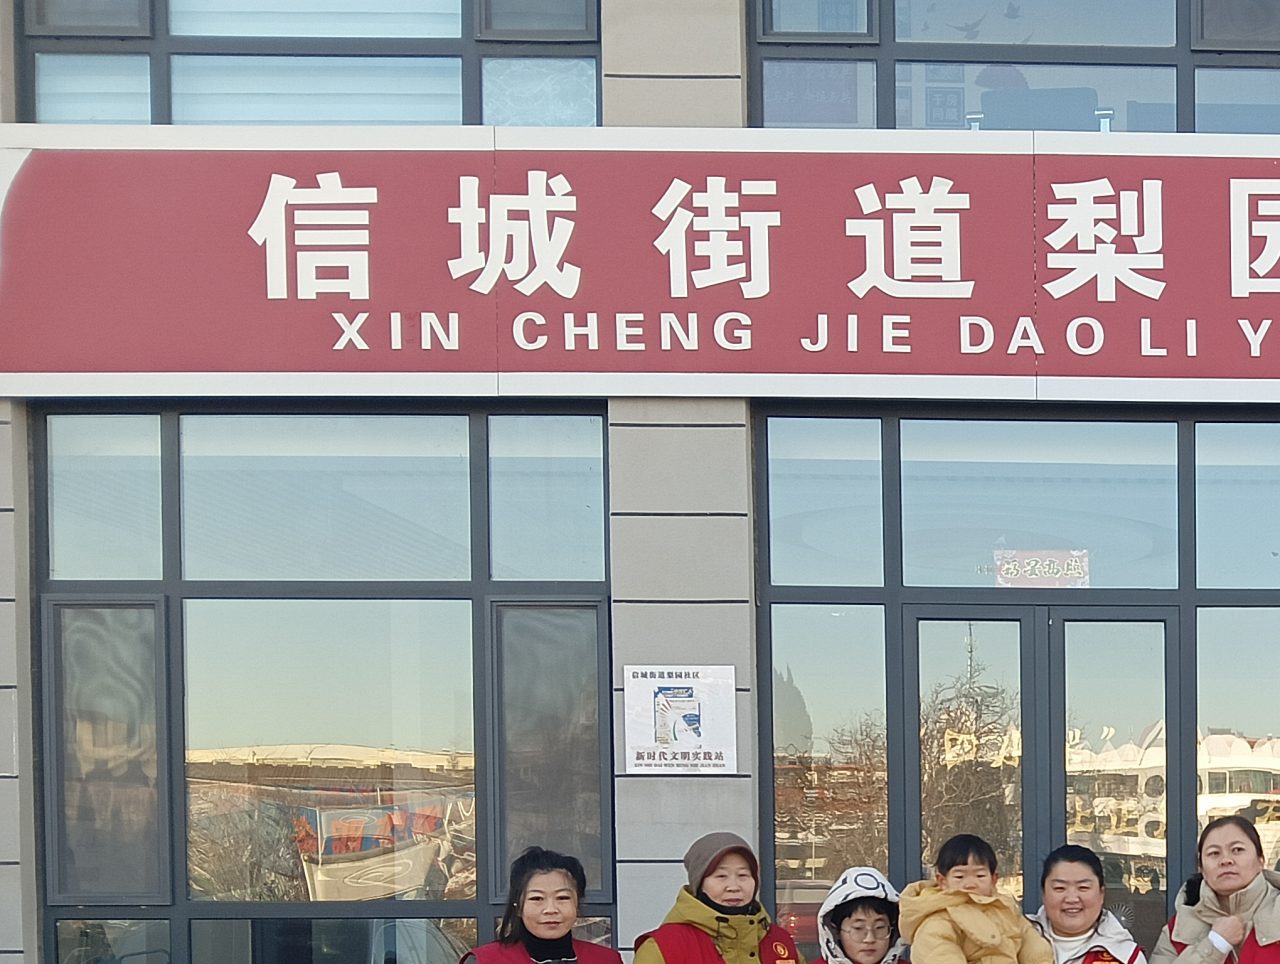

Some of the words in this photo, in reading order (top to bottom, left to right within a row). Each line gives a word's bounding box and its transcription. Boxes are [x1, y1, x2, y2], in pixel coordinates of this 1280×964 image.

[331, 312, 460, 351] XIN
[512, 311, 754, 352] CHENG
[801, 313, 913, 354] JIE
[960, 315, 1105, 356] DAO
[1140, 318, 1198, 357] LI
